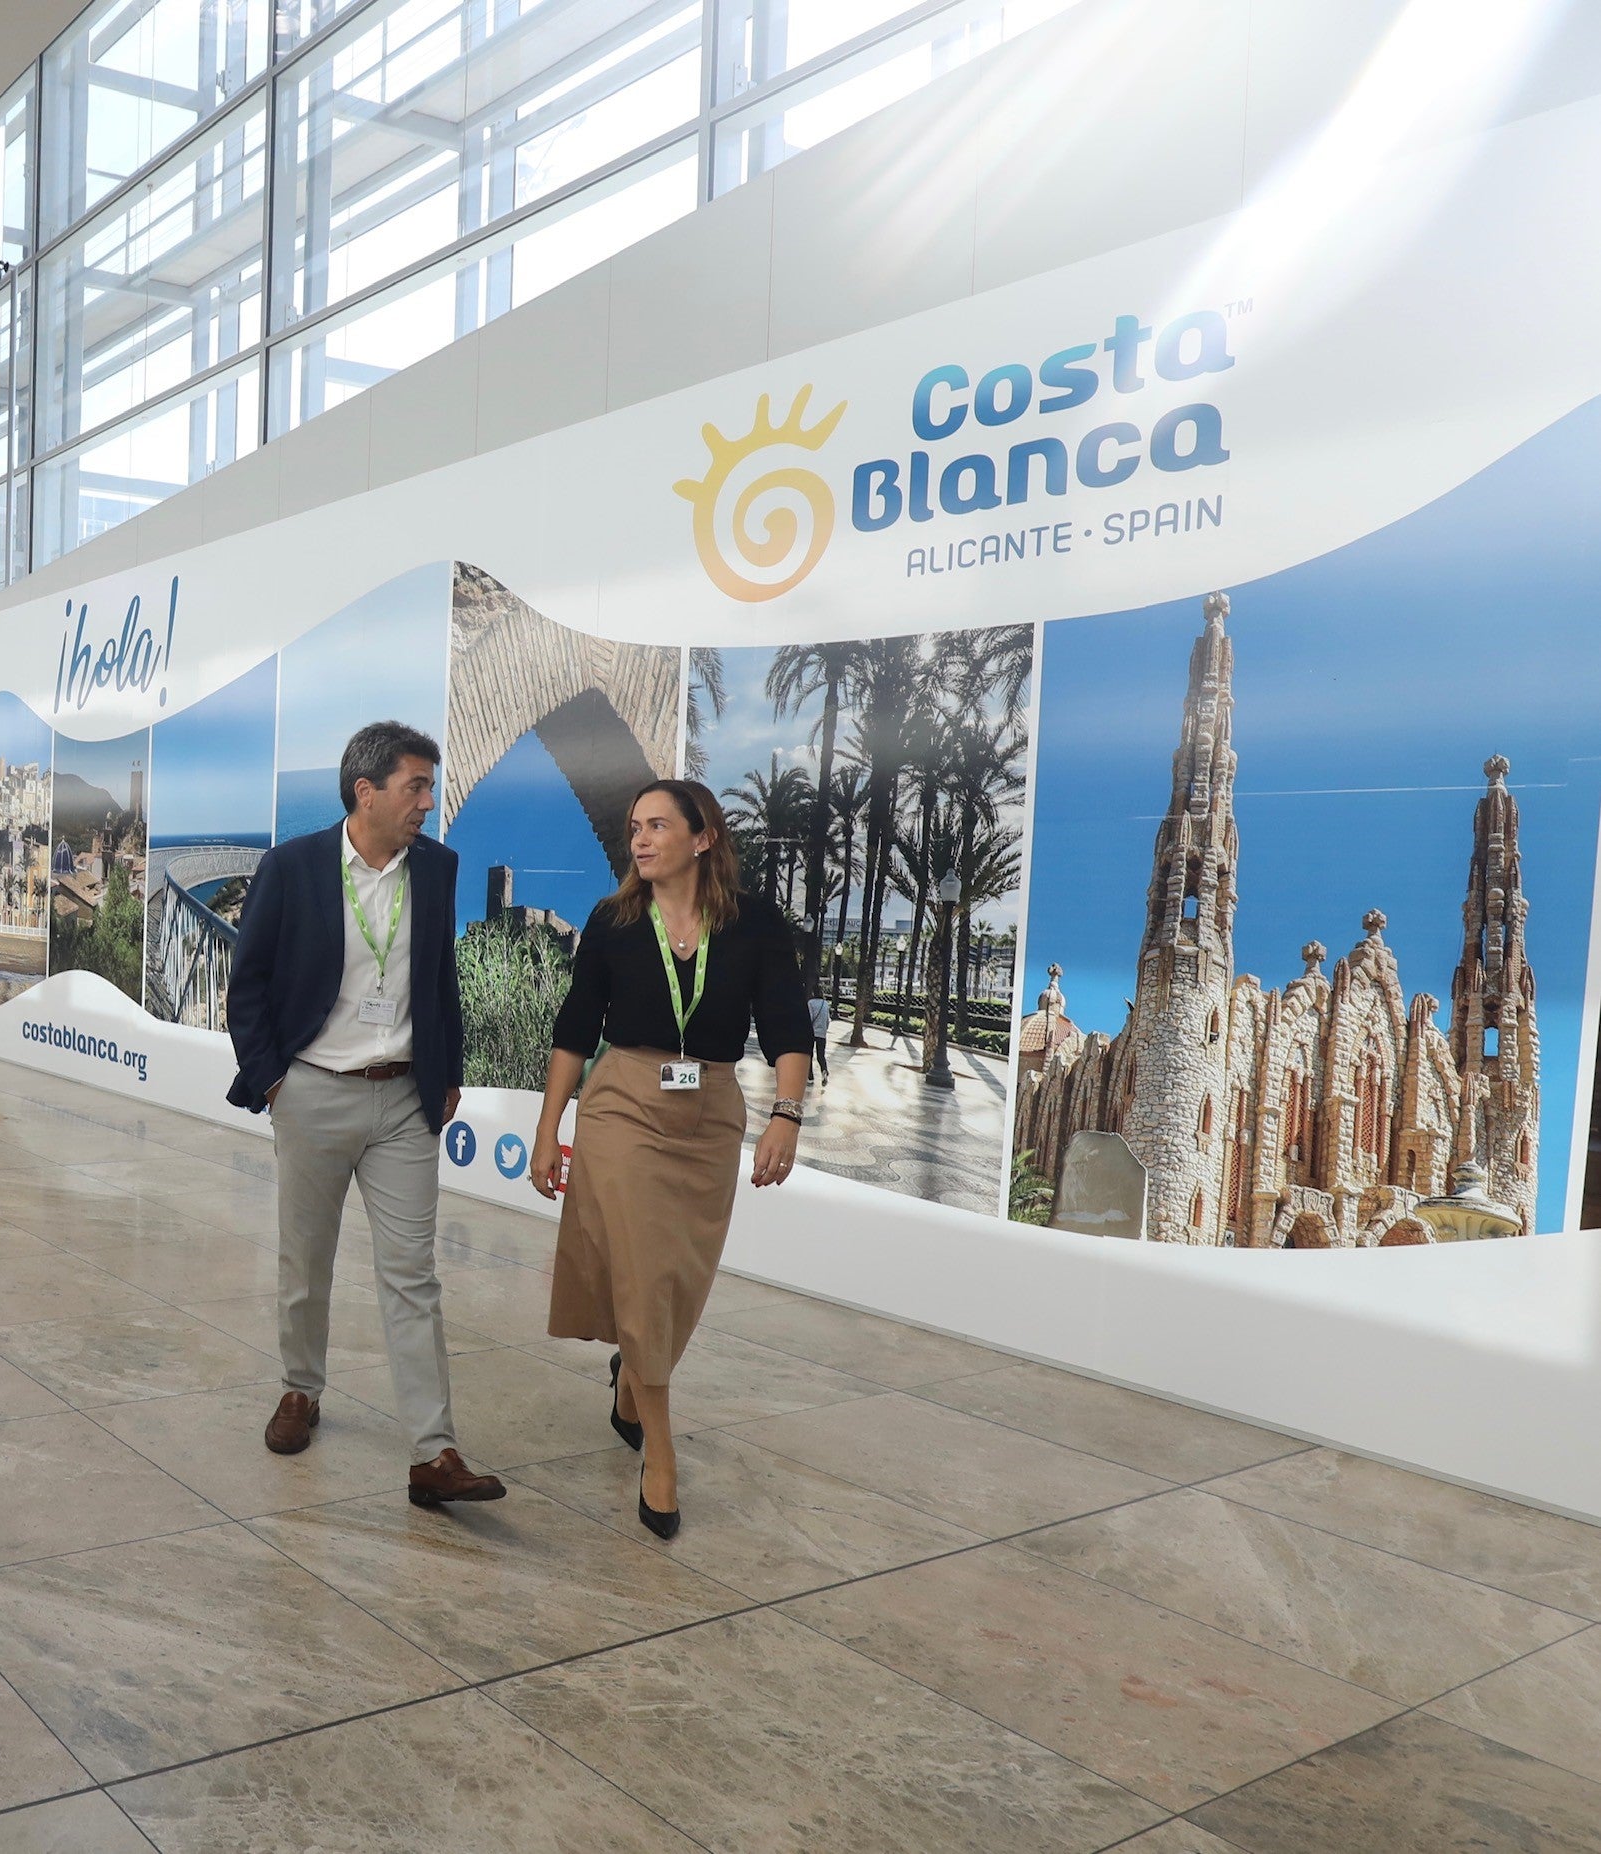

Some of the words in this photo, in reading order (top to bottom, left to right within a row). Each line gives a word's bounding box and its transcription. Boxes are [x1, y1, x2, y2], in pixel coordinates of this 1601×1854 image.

[912, 311, 1236, 441] Costa
[852, 403, 1230, 532] Blanca
[907, 522, 1073, 578] ALICANTE
[1103, 494, 1223, 546] SPAIN
[54, 575, 179, 715] ¡hola!
[22, 1020, 148, 1082] costablanca.org
[679, 1073, 696, 1084] 26
